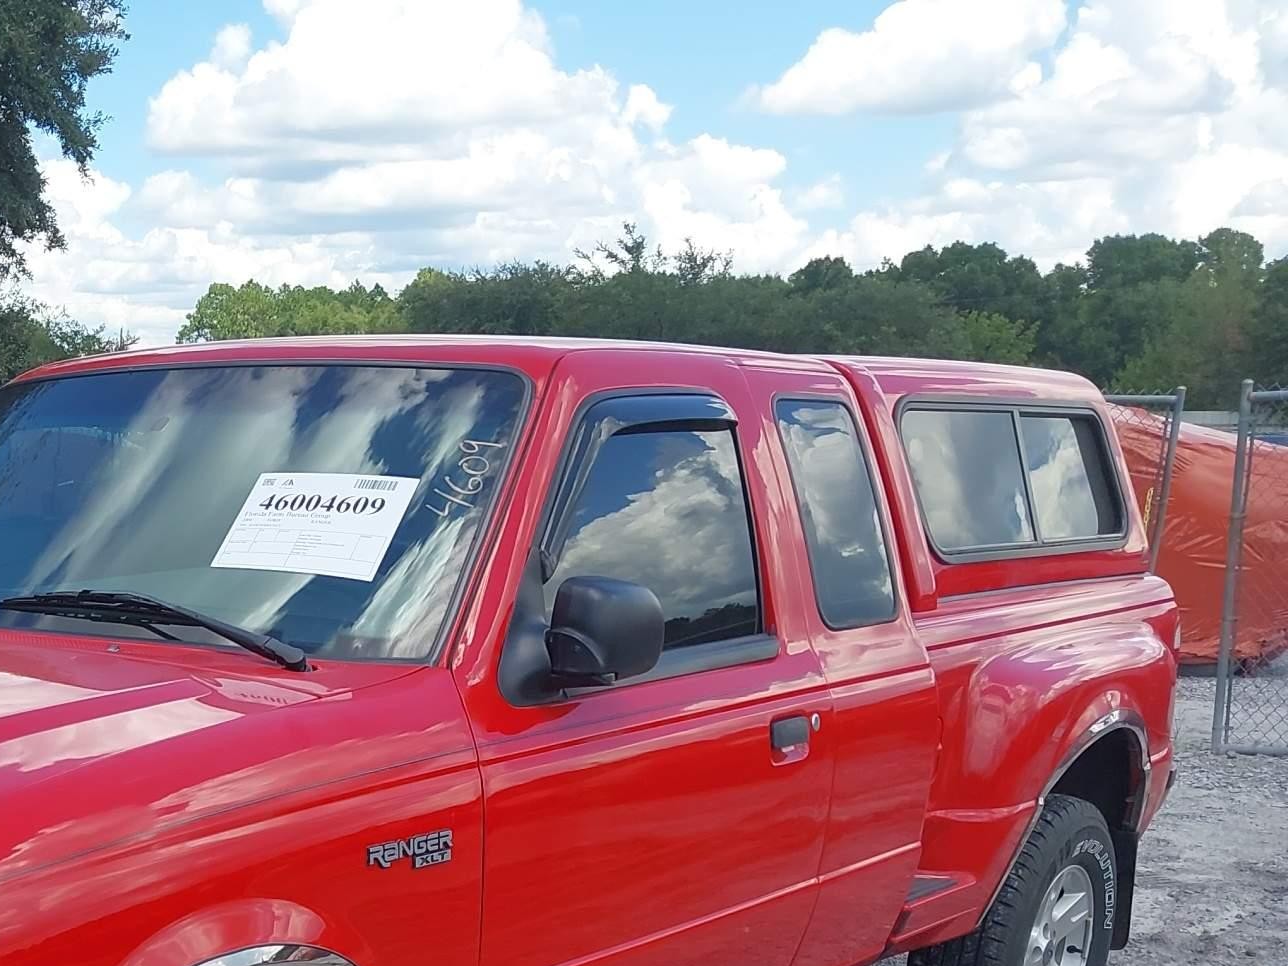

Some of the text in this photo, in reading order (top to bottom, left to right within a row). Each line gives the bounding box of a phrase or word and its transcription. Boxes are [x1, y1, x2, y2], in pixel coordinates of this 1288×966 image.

[425, 439, 506, 517] 4609
[258, 493, 386, 516] 46004609
[417, 851, 449, 867] XLT
